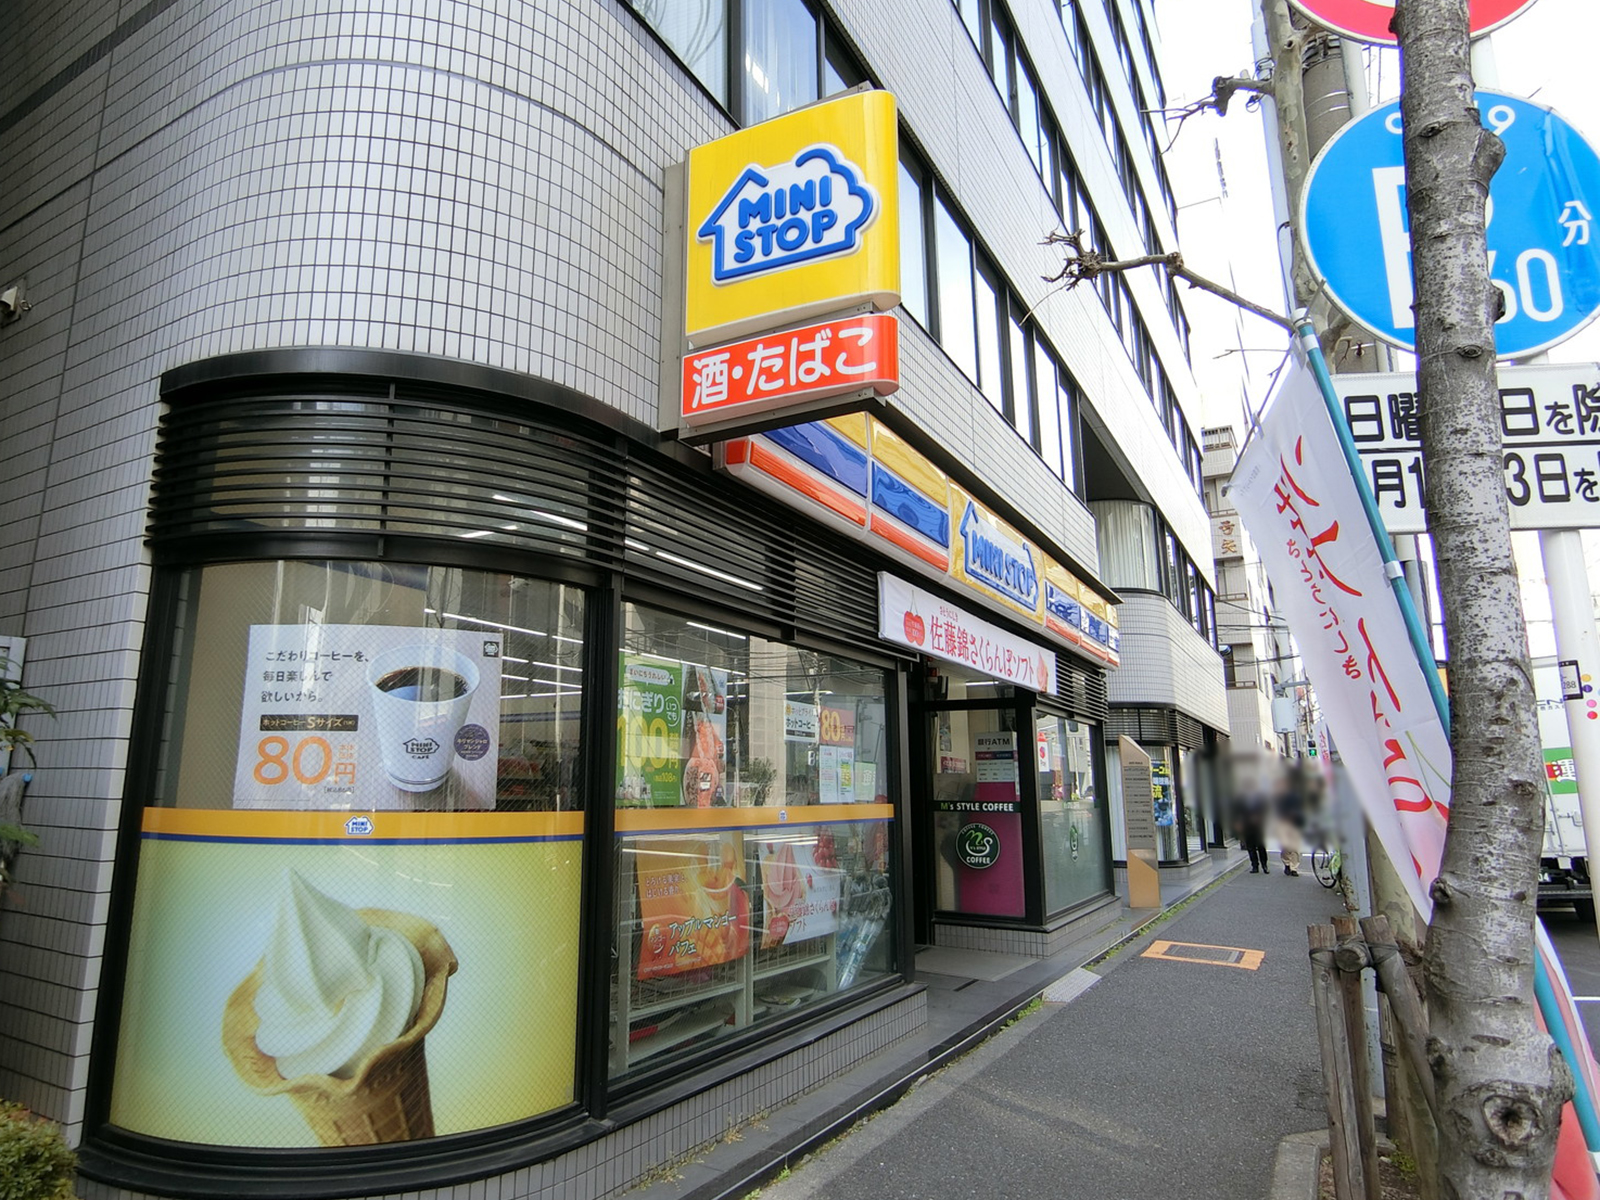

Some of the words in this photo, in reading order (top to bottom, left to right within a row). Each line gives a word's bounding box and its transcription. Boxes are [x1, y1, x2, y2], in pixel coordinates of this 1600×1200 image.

[738, 174, 833, 229] MINI
[1558, 200, 1592, 247] 分
[733, 208, 838, 263] STOP
[691, 327, 877, 409] 酒・たばこ
[972, 530, 1003, 581] MINI
[1005, 553, 1034, 598] STOP
[930, 614, 1035, 684] 佐藤錦さくらんぼソフト
[786, 717, 815, 730] ホットコーヒー
[821, 709, 840, 742] 80
[253, 735, 333, 786] 80
[334, 761, 356, 785] 円
[956, 802, 980, 811] STYLE
[982, 802, 1014, 812] COFFEE
[966, 856, 991, 865] COFFEE
[668, 910, 737, 940] アップルマンゴー
[668, 939, 697, 957] パフェ
